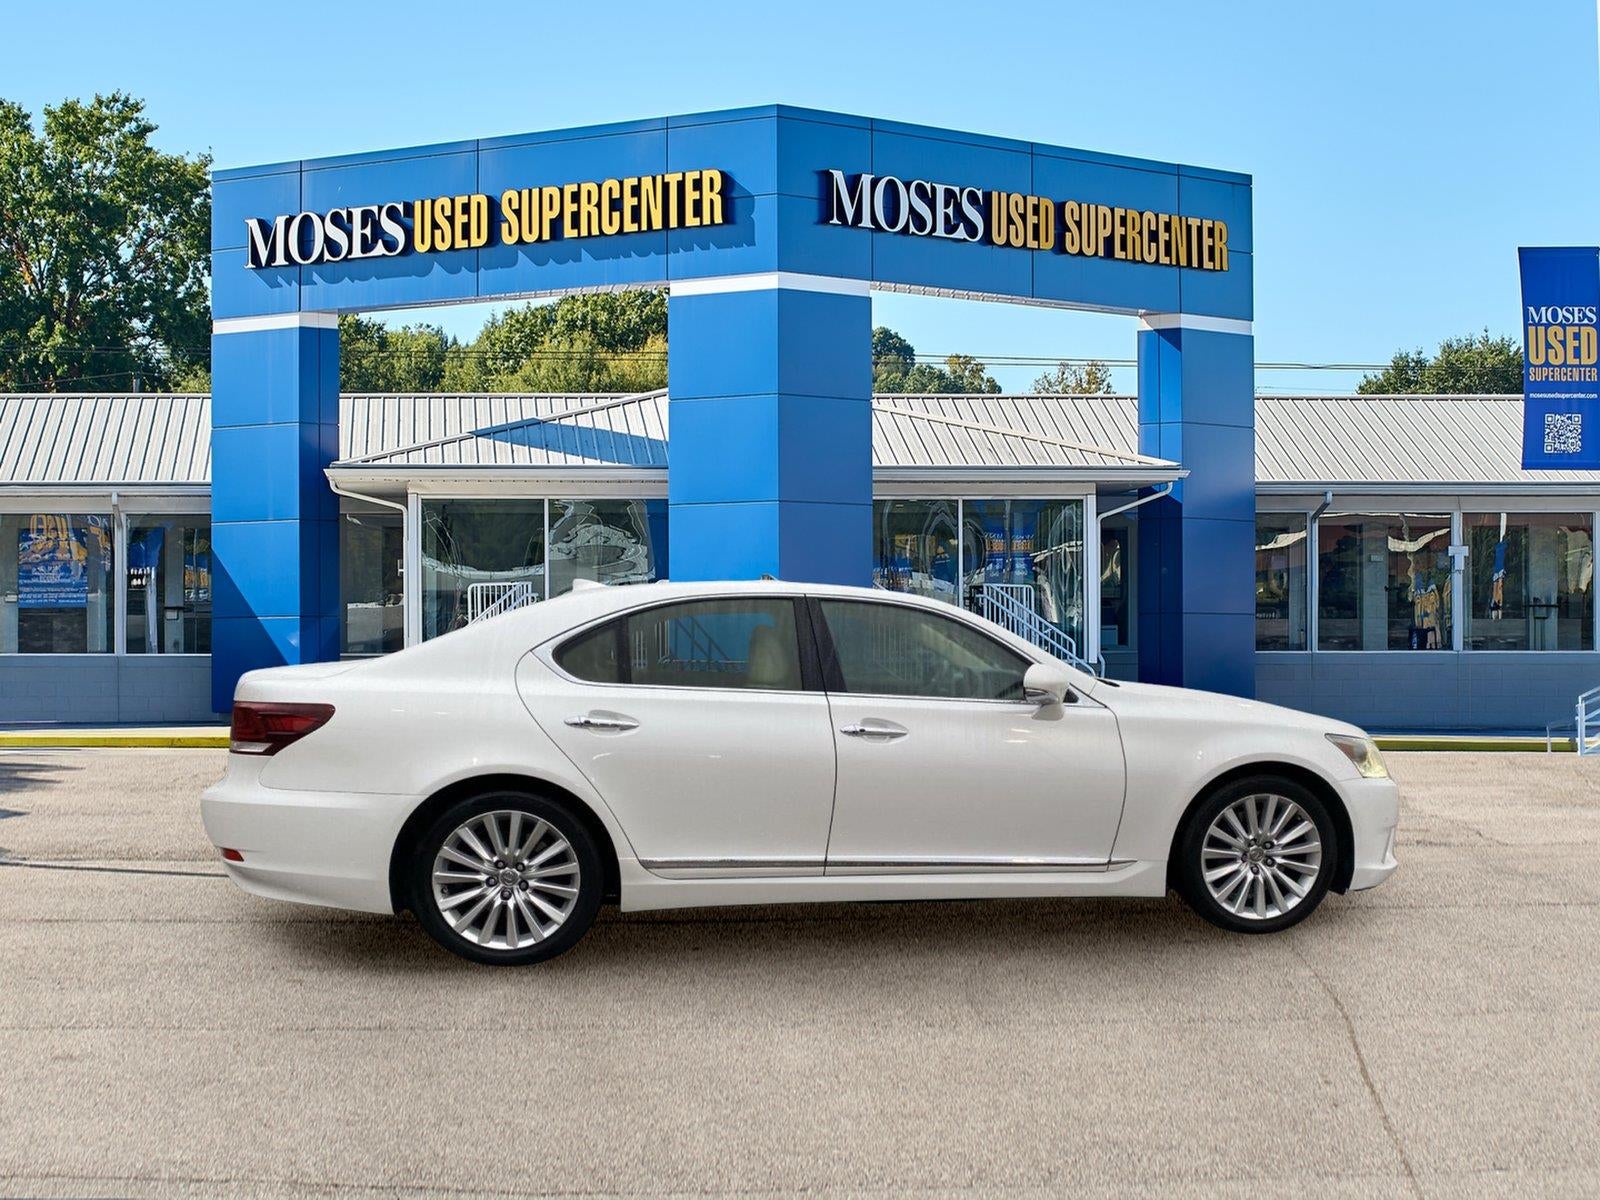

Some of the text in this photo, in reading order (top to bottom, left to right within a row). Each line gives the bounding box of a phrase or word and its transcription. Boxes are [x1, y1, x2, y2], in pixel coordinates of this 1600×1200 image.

[246, 169, 723, 269] MOSES USED SUPERCENTER
[829, 169, 1229, 271] MOSES USED SUPERCENTER
[1527, 306, 1597, 324] MOSES
[1528, 326, 1598, 365] USED
[1529, 367, 1598, 382] SUPERCENTER
